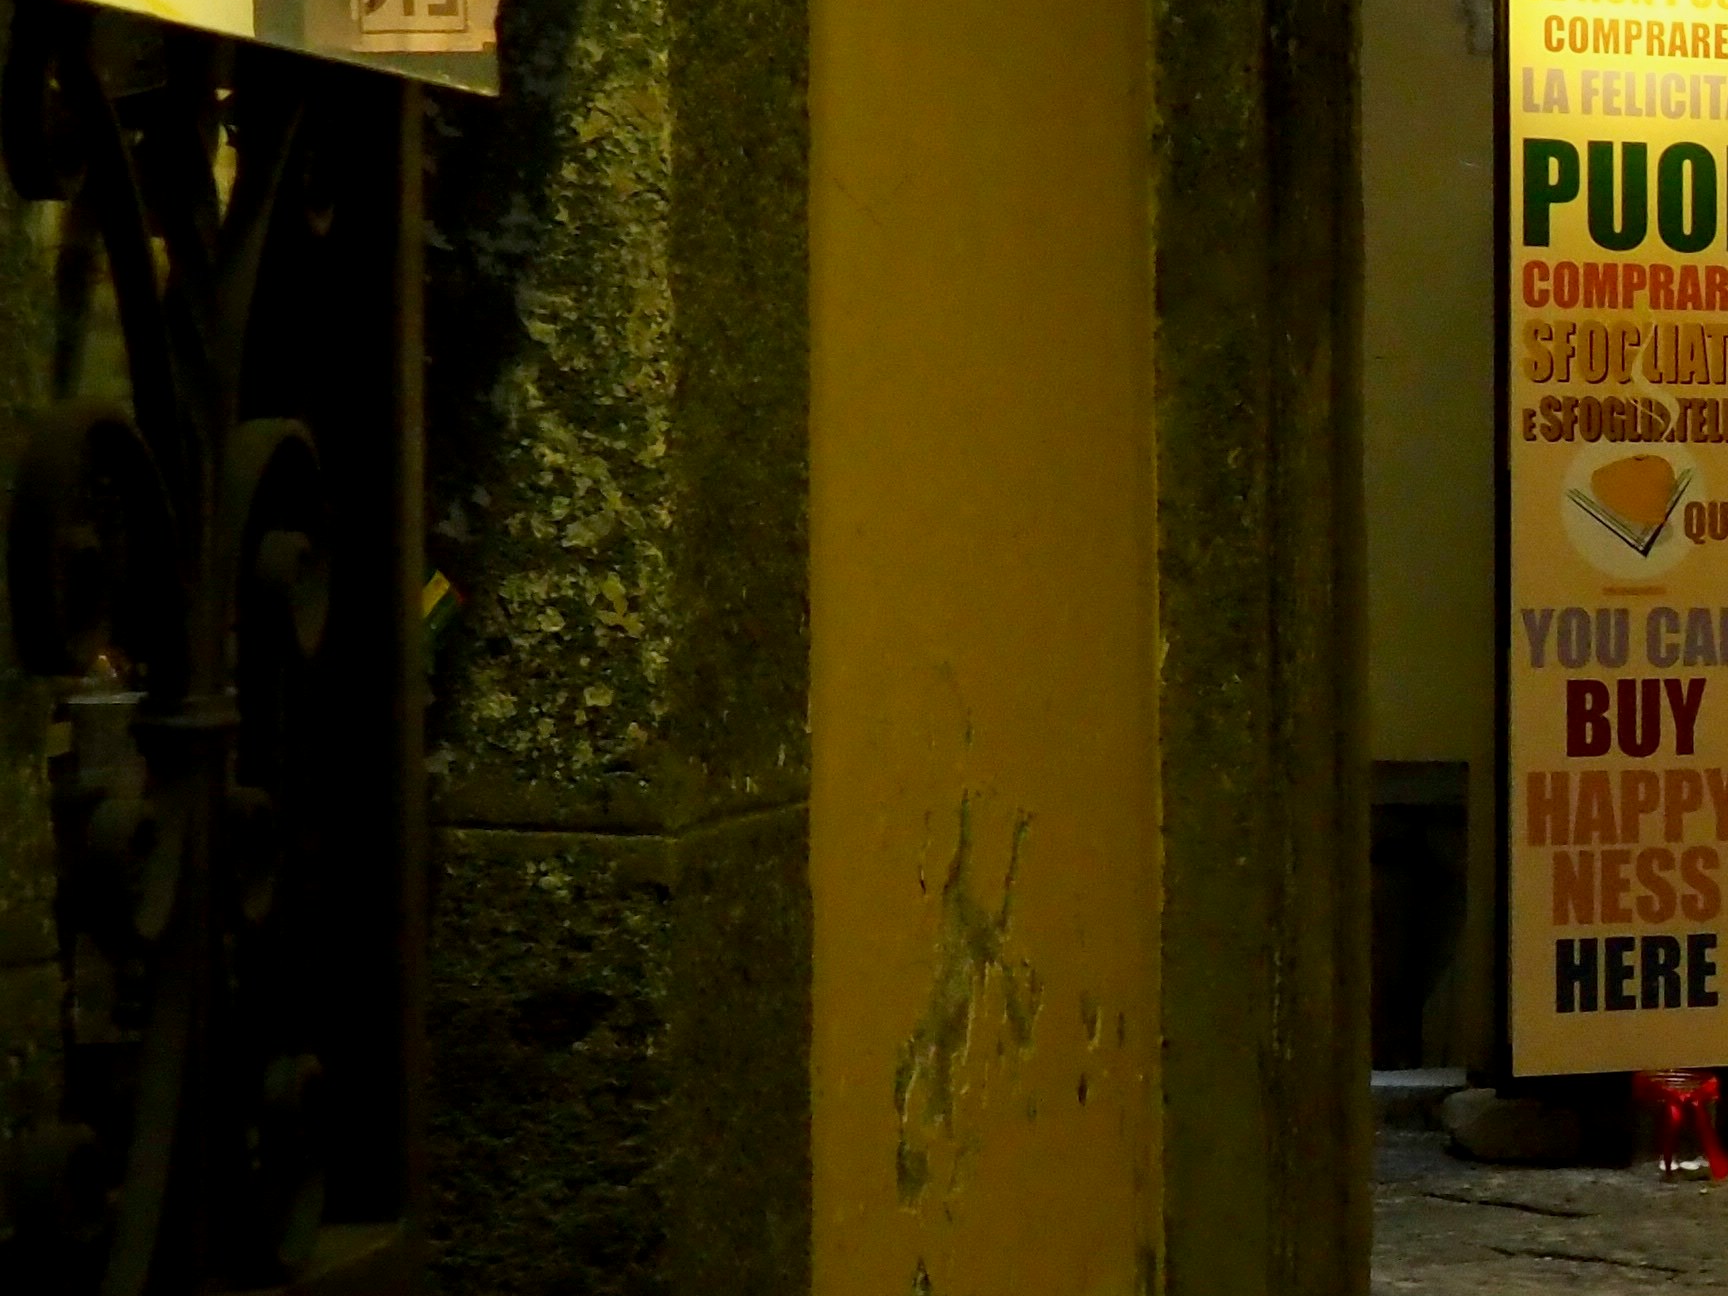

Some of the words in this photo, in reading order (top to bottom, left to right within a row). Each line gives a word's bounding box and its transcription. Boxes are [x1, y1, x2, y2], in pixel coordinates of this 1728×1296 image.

[1521, 66, 1570, 116] LA
[1520, 606, 1630, 670] YOU
[1565, 677, 1707, 759] BUY
[1551, 846, 1722, 926] NESS
[1555, 933, 1720, 1014] HERE
